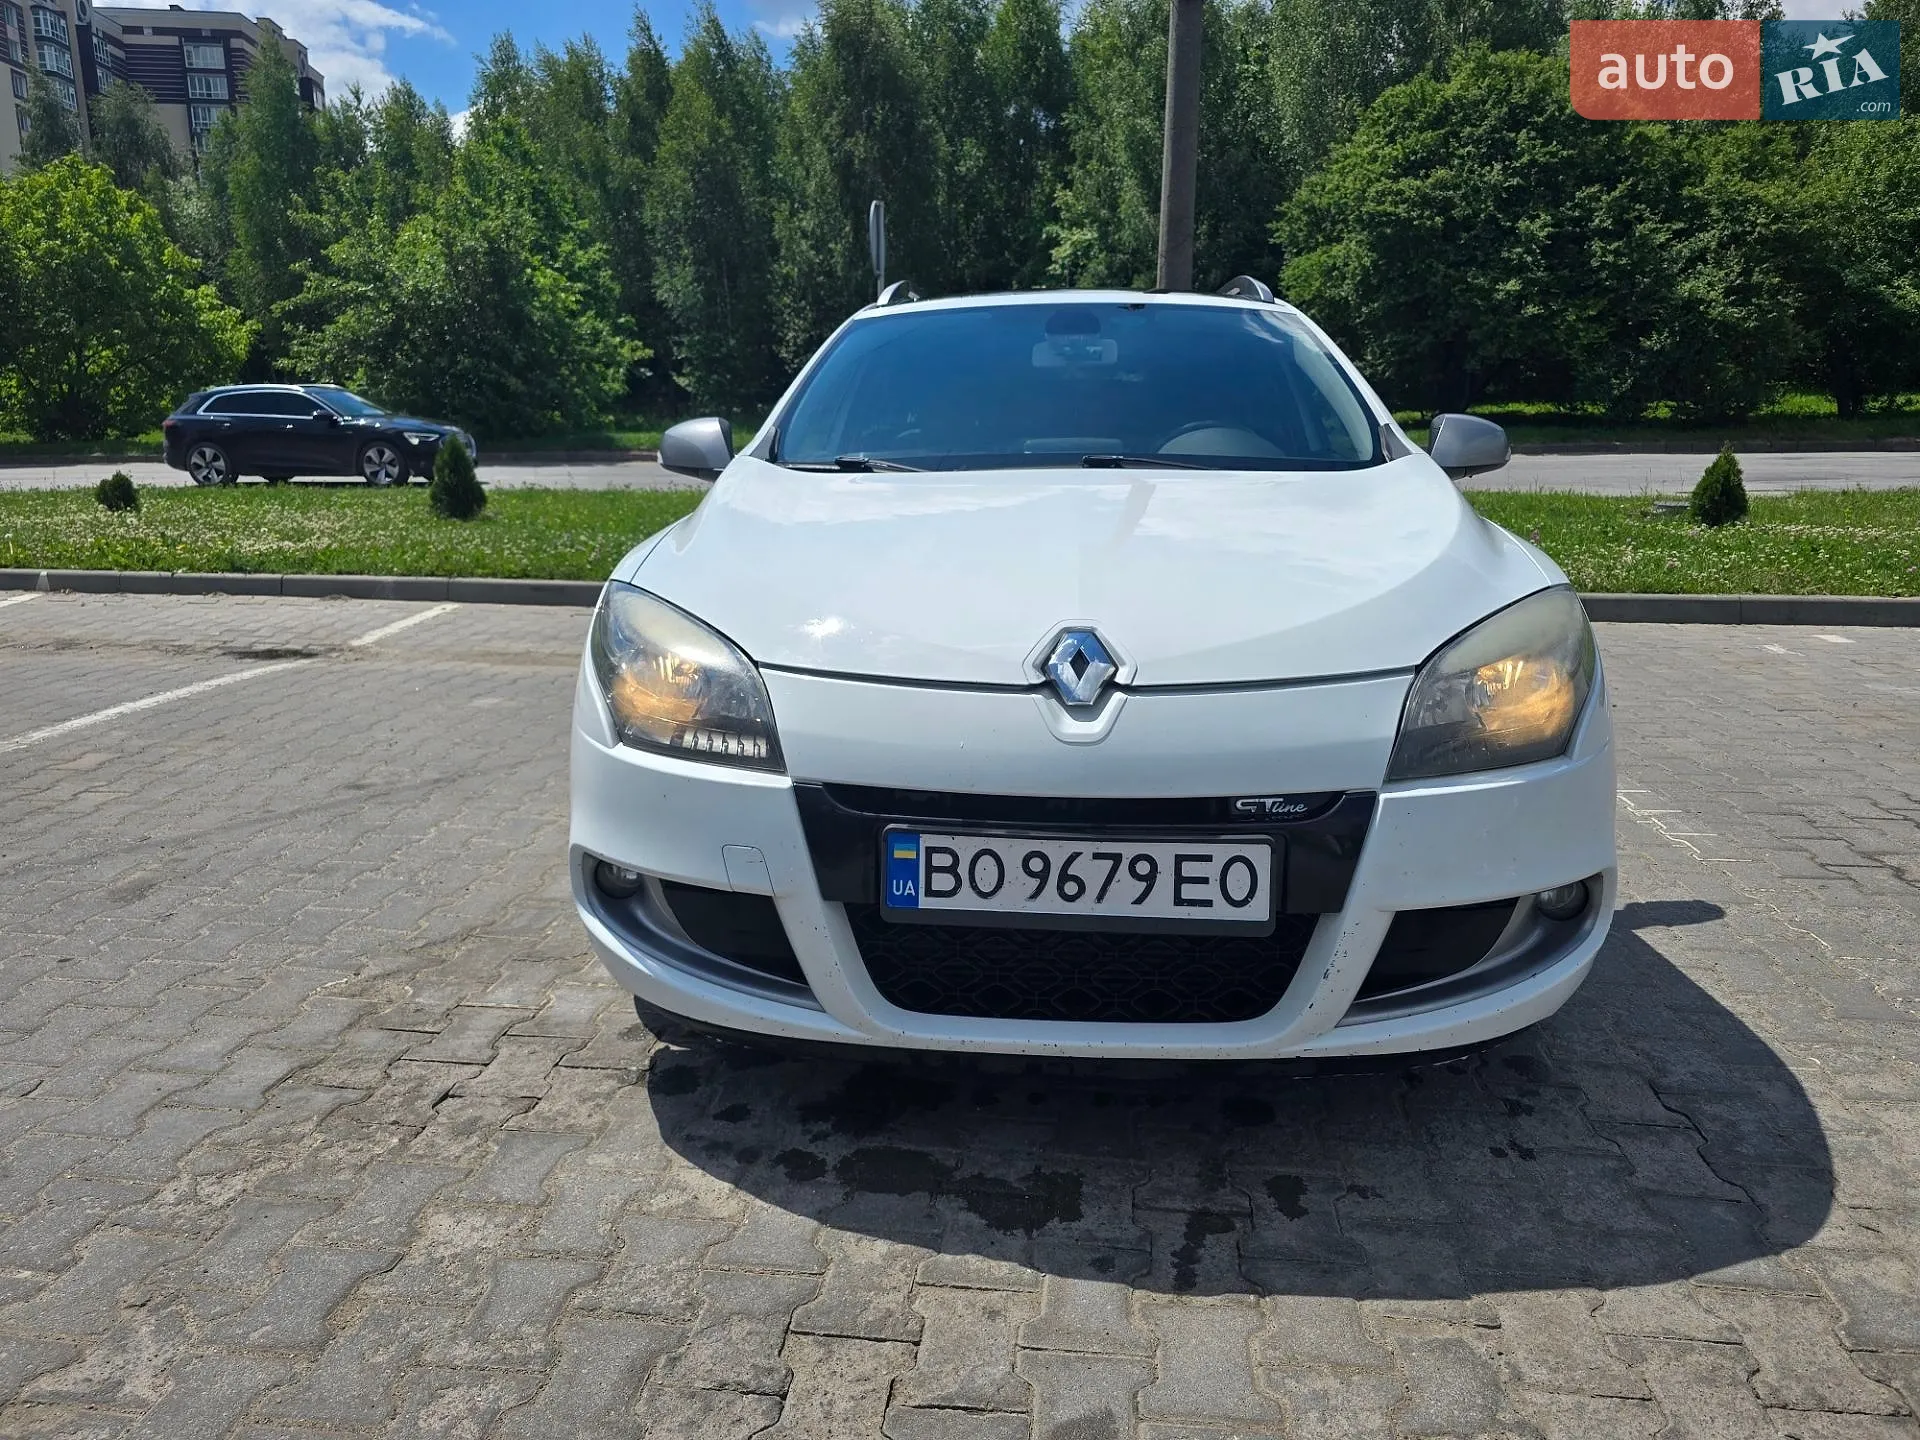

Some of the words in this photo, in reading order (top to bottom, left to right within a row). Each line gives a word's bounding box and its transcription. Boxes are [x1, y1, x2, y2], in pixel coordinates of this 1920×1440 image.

[892, 879, 916, 897] UA
[923, 846, 1006, 900] BO
[1021, 850, 1159, 906] 9679
[1173, 854, 1259, 908] EO
